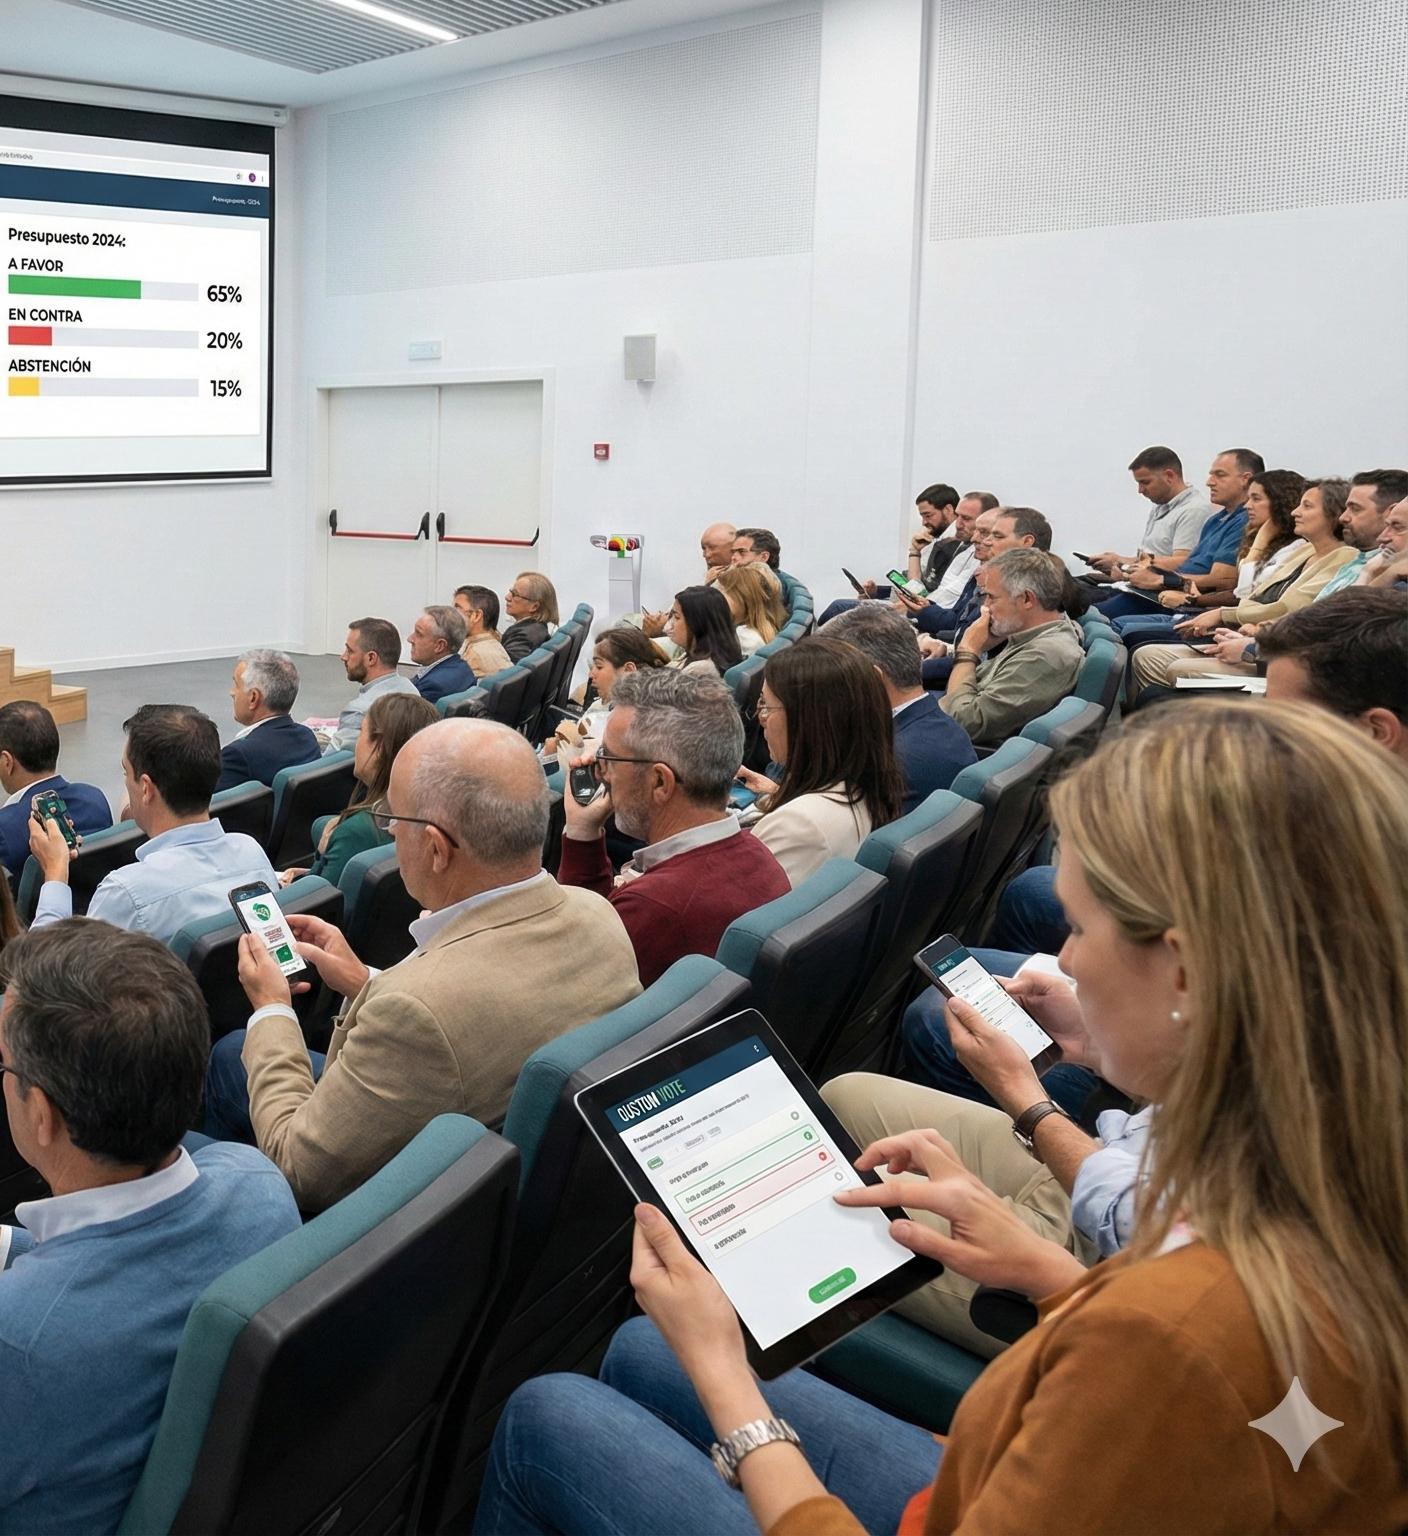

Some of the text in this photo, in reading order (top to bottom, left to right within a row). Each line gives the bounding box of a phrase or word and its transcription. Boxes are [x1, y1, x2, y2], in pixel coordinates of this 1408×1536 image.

[8, 228, 126, 247] Presupuesto 2024:
[8, 258, 63, 272] A FAVOR
[207, 285, 242, 303] 65%
[8, 308, 83, 322] EN CONTRA
[206, 332, 243, 349] 20%
[8, 357, 91, 372] ABSTENCIÓN
[210, 380, 242, 397] 15%
[656, 1079, 686, 1102] VOTE
